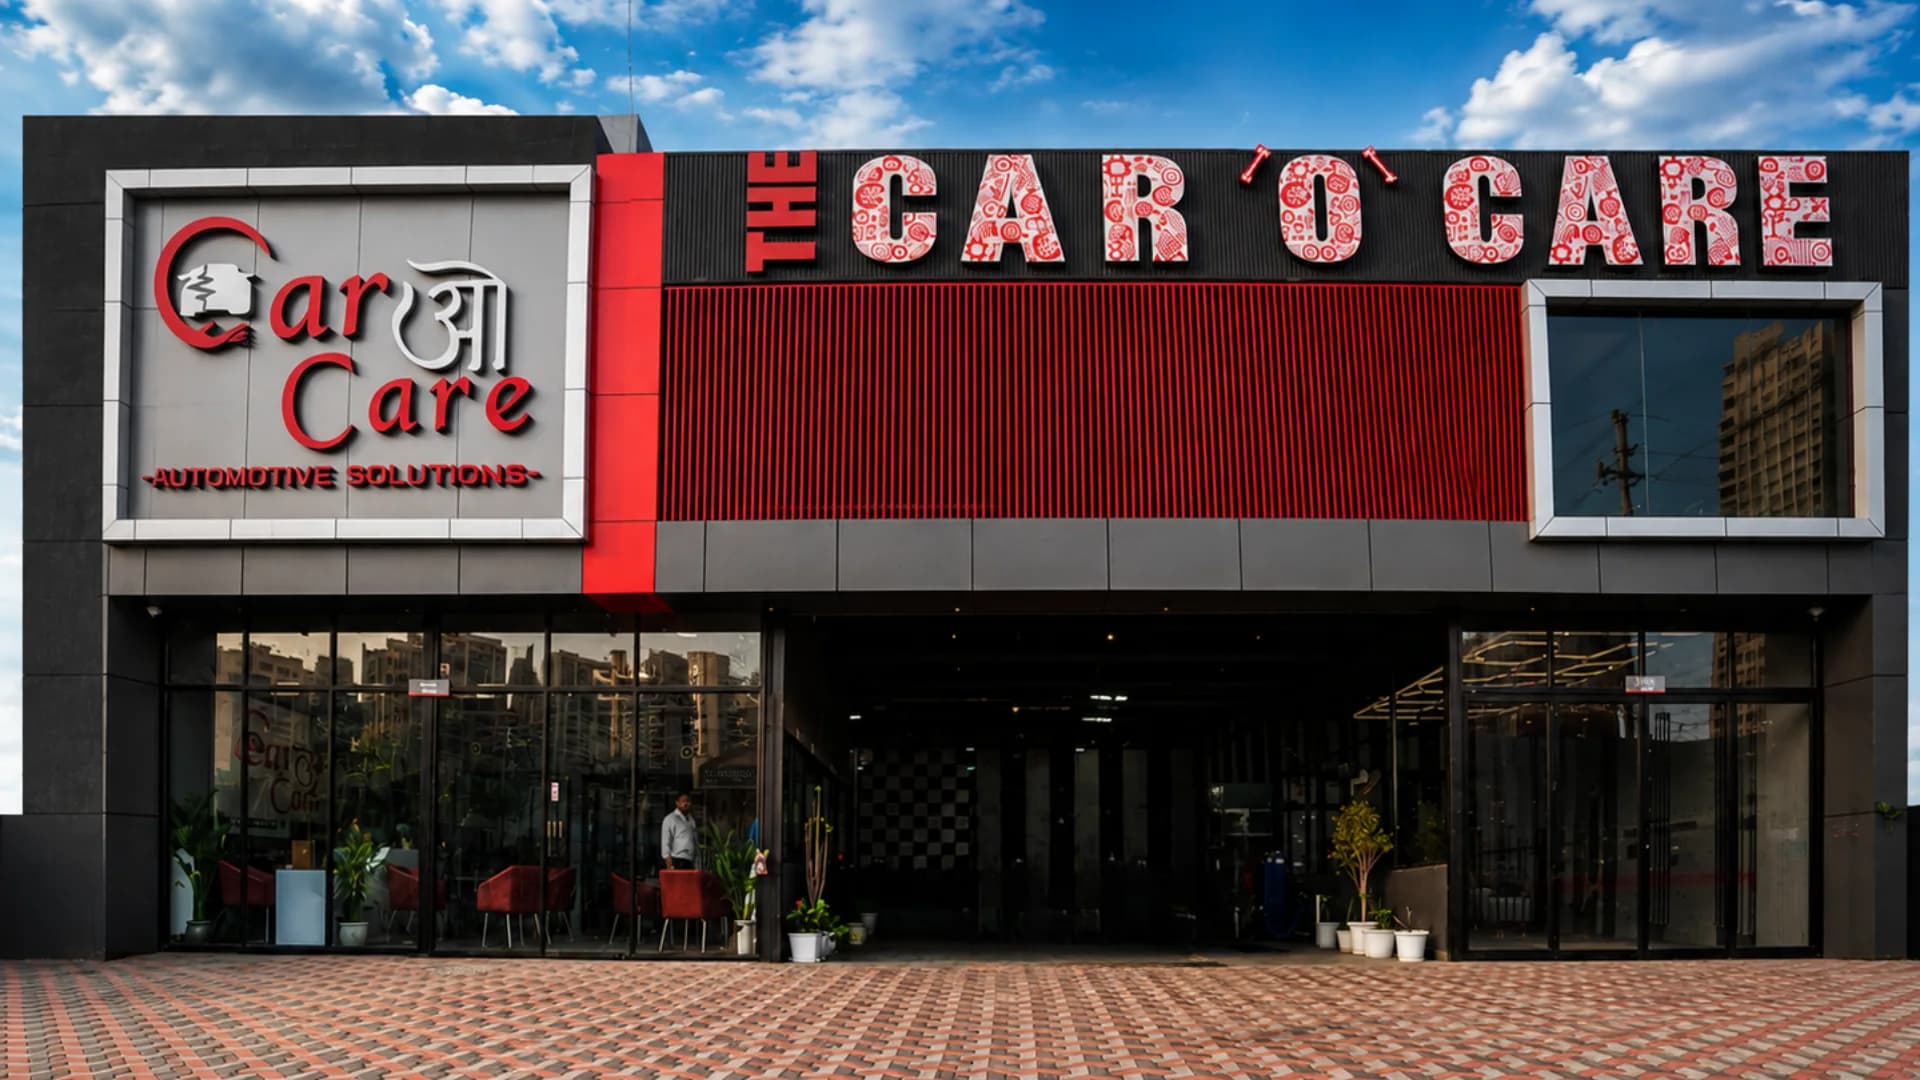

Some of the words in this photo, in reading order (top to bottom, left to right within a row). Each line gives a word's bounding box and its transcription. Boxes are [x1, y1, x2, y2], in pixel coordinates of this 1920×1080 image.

[746, 151, 817, 272] THE
[852, 154, 1189, 263] CAR
[1443, 154, 1834, 266] CARE
[154, 216, 391, 349] Car
[282, 352, 534, 450] Care
